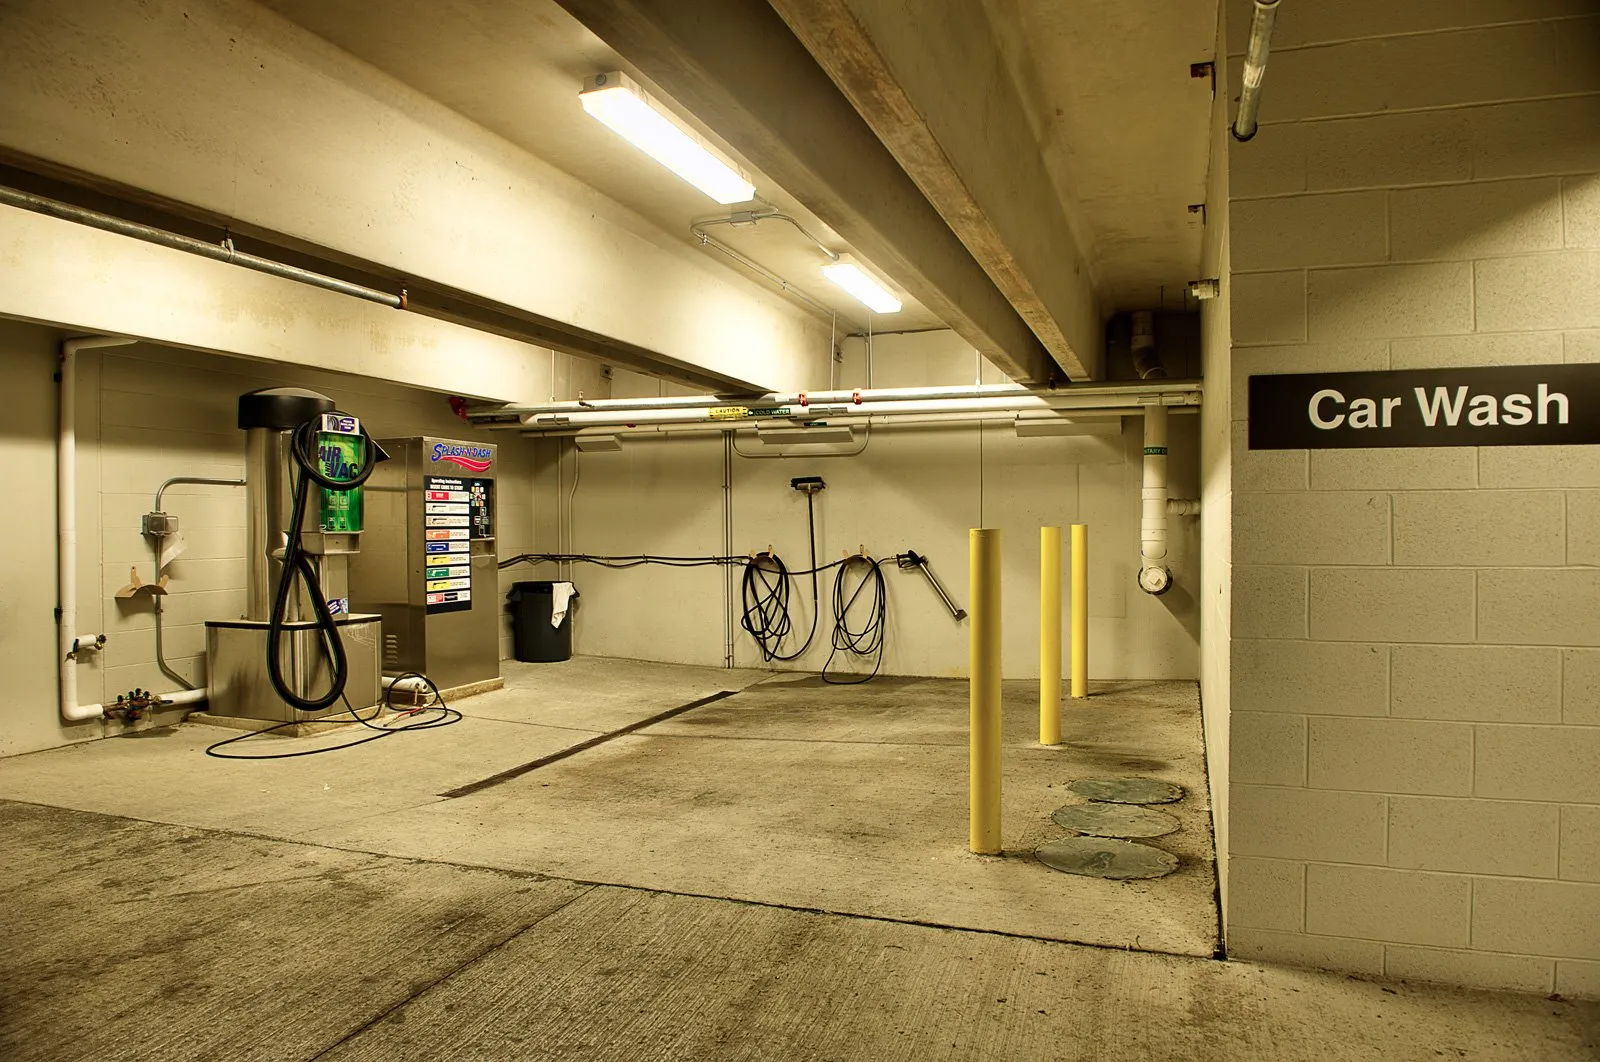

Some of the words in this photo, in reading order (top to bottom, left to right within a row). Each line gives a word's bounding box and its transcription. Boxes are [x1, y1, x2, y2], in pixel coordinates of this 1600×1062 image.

[1308, 389, 1402, 430] Car
[1414, 383, 1570, 428] Wash
[319, 445, 342, 463] AIR
[330, 462, 359, 479] VAC
